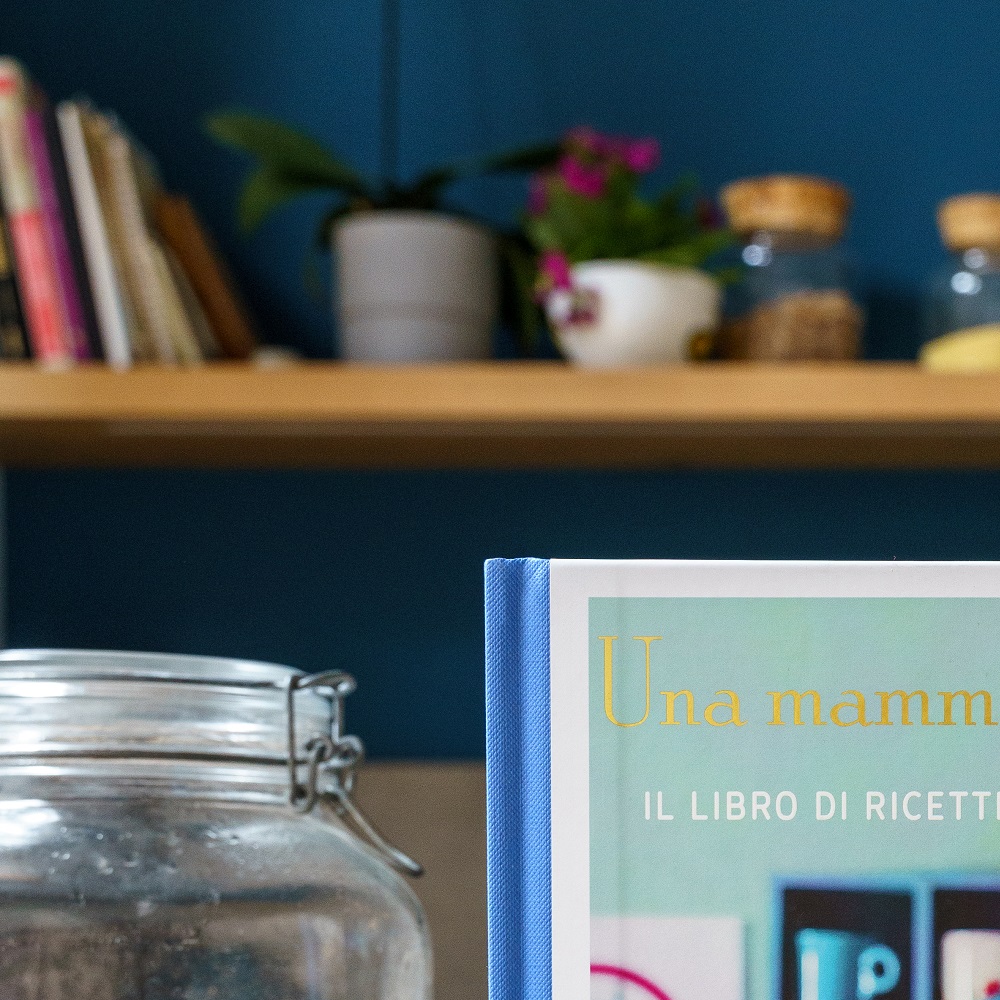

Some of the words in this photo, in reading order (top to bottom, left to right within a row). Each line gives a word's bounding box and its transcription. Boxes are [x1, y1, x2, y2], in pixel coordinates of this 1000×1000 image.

[598, 635, 746, 728] Una
[643, 790, 675, 821] IL
[690, 790, 798, 821] LIBRO
[815, 790, 848, 821] DI
